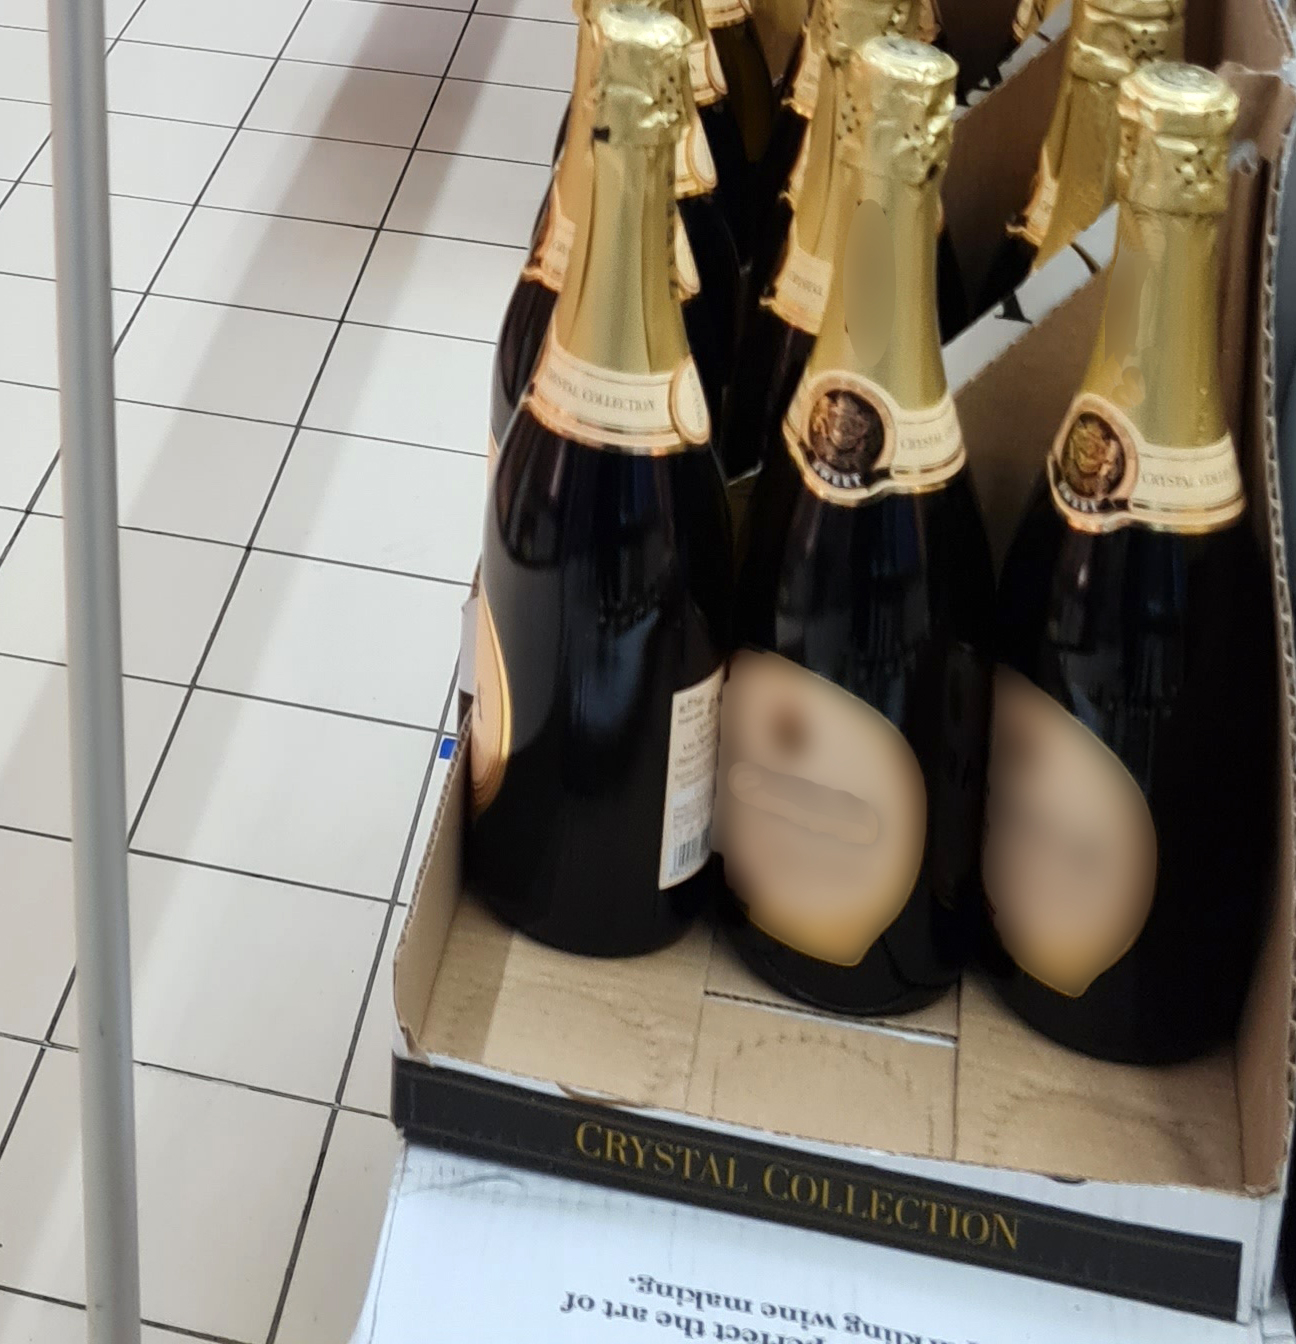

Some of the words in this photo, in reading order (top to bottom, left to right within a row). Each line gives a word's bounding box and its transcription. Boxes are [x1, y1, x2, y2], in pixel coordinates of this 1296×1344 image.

[575, 1121, 749, 1194] CRYSTAL
[762, 1162, 1020, 1250] COLLECTION
[561, 1291, 595, 1314] of
[602, 1300, 649, 1324] art
[655, 1308, 705, 1337] the
[628, 1274, 752, 1313] making.
[759, 1302, 836, 1330] wine
